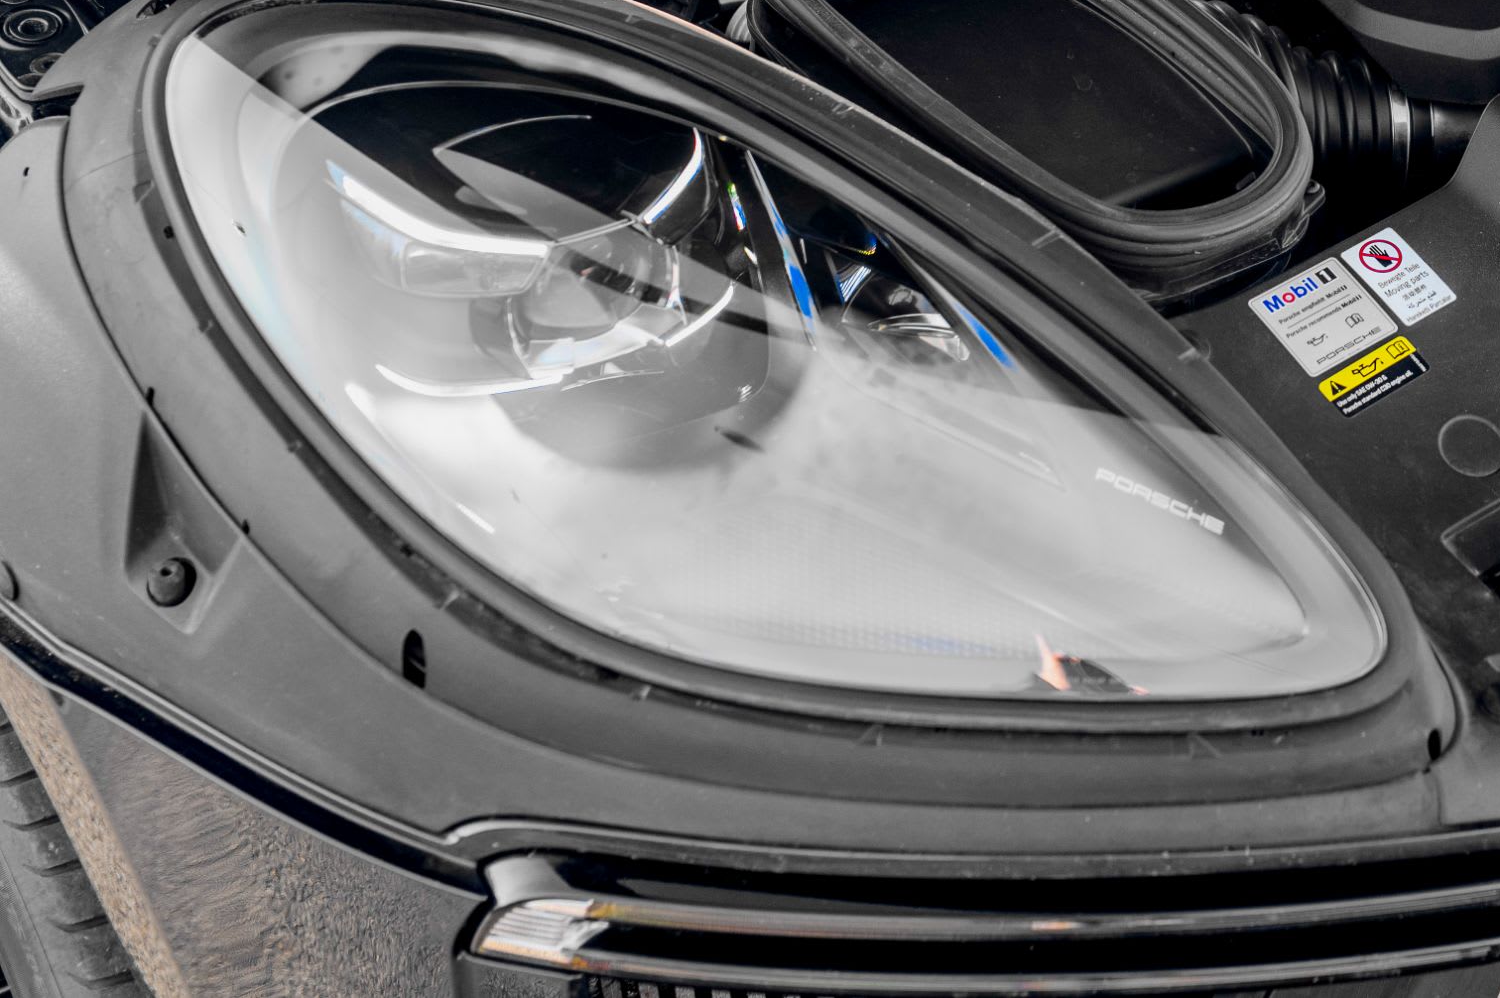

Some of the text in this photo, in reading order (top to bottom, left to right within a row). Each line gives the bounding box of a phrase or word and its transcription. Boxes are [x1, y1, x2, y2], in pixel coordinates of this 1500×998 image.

[1262, 277, 1319, 313] Mobil
[1377, 271, 1407, 289] Bewegte
[1384, 270, 1430, 298] Moving parts
[1316, 326, 1381, 364] PORSCHE
[1095, 467, 1225, 536] PORSCHE
